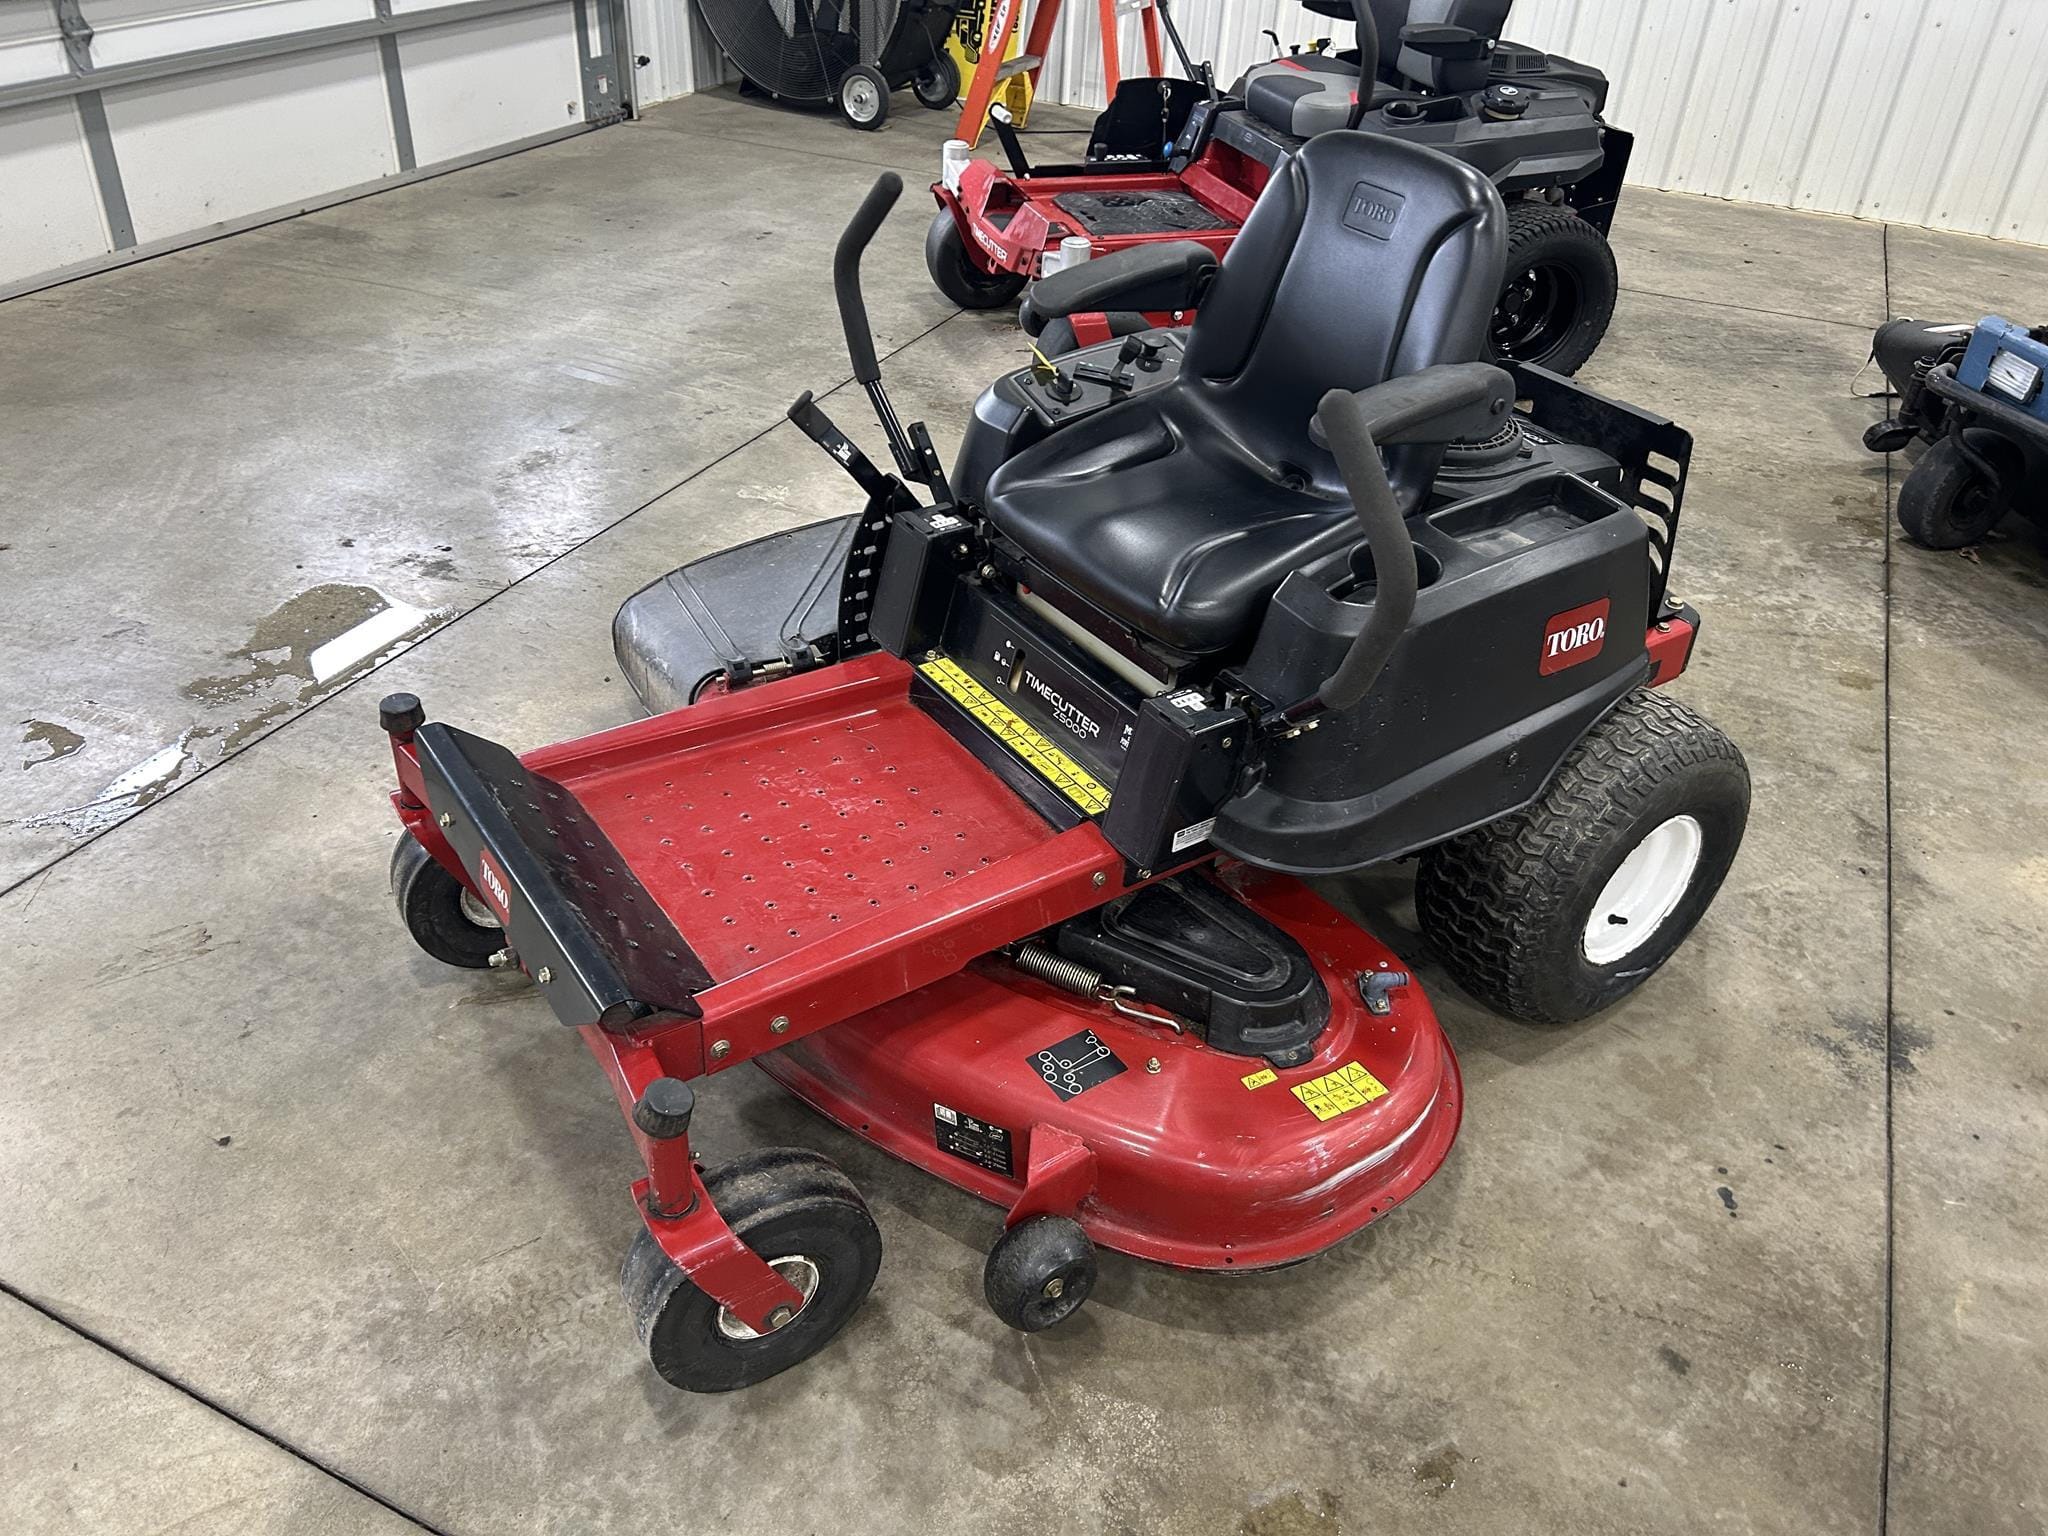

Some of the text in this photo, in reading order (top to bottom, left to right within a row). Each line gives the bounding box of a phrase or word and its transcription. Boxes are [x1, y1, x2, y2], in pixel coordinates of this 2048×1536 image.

[1353, 197, 1396, 225] TORO
[972, 222, 1008, 263] TIMECUTTER
[1547, 617, 1604, 658] TORO
[1025, 670, 1100, 738] TIMECUTTER
[1053, 708, 1087, 739] Z5000
[482, 859, 509, 910] TORO
